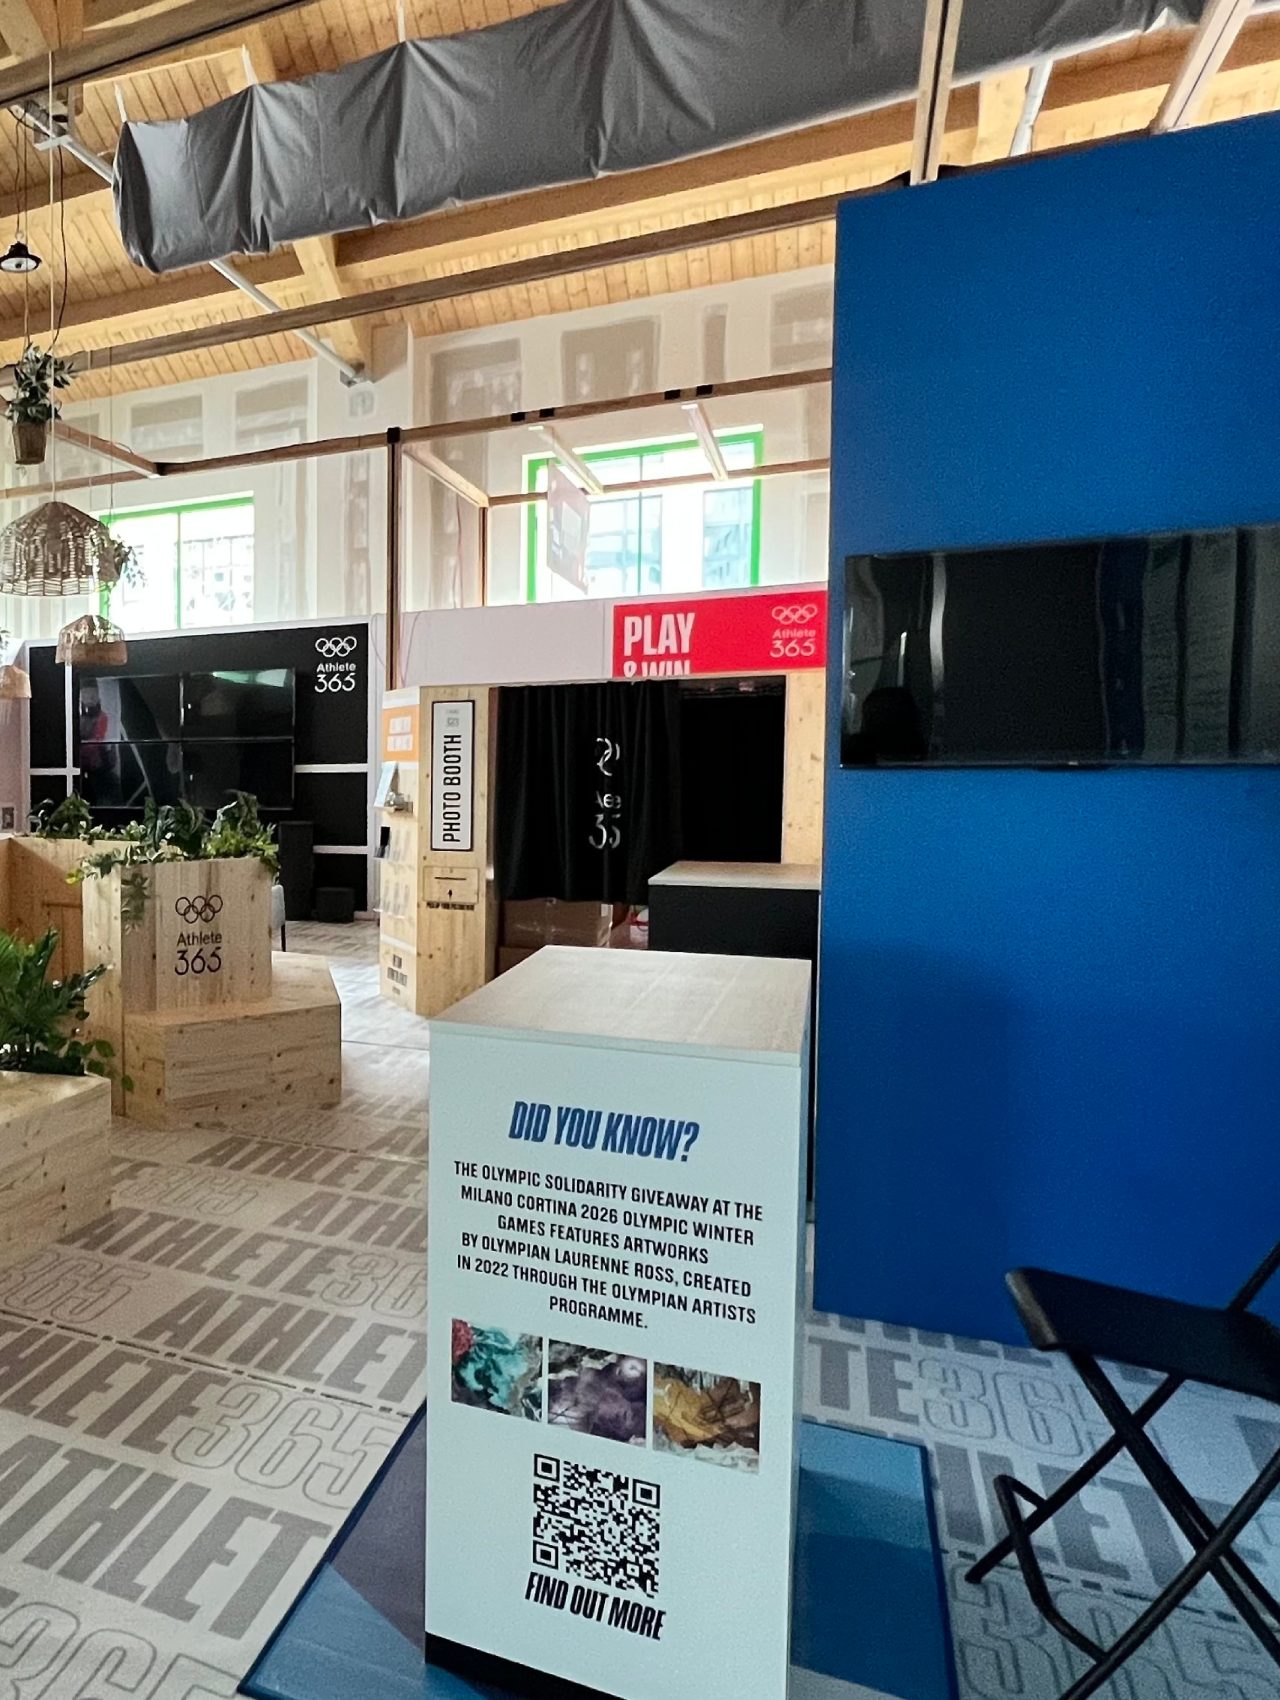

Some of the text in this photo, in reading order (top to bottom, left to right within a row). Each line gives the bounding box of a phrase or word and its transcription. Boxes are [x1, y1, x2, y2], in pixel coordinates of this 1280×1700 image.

[624, 612, 696, 656] PLAY
[770, 638, 816, 658] 365
[772, 628, 816, 639] Athlete
[314, 673, 357, 693] 365
[316, 662, 357, 673] Athlete
[443, 734, 462, 786] BOOTH
[442, 792, 461, 842] PHOTO
[174, 946, 222, 975] 365
[176, 931, 222, 947] Athlete
[508, 1101, 700, 1162] DID YOU KNOW?
[186, 1134, 428, 1198] ATHLETE
[454, 1161, 763, 1222] THE OLYMPIC SOLIDARITY GIVEAWAY AT THE
[461, 1185, 754, 1246] MILANO CORTINA 2026 OLYMPIC WINTER
[498, 1215, 709, 1264] GAMES FEATURES ARTWORKS
[56, 1206, 353, 1298] ATHLETE
[461, 1232, 751, 1298] BY OLYMPIAN LAURENNE ROSS, CREATED
[457, 1254, 756, 1324] IN 2022 THROUGH THE OLYMPIAN ARTISTS
[549, 1296, 648, 1329] PROGRAMME.
[133, 1287, 427, 1406] ATHLET
[172, 1383, 410, 1510] 365
[525, 1571, 666, 1641] FIND OUT MORE
